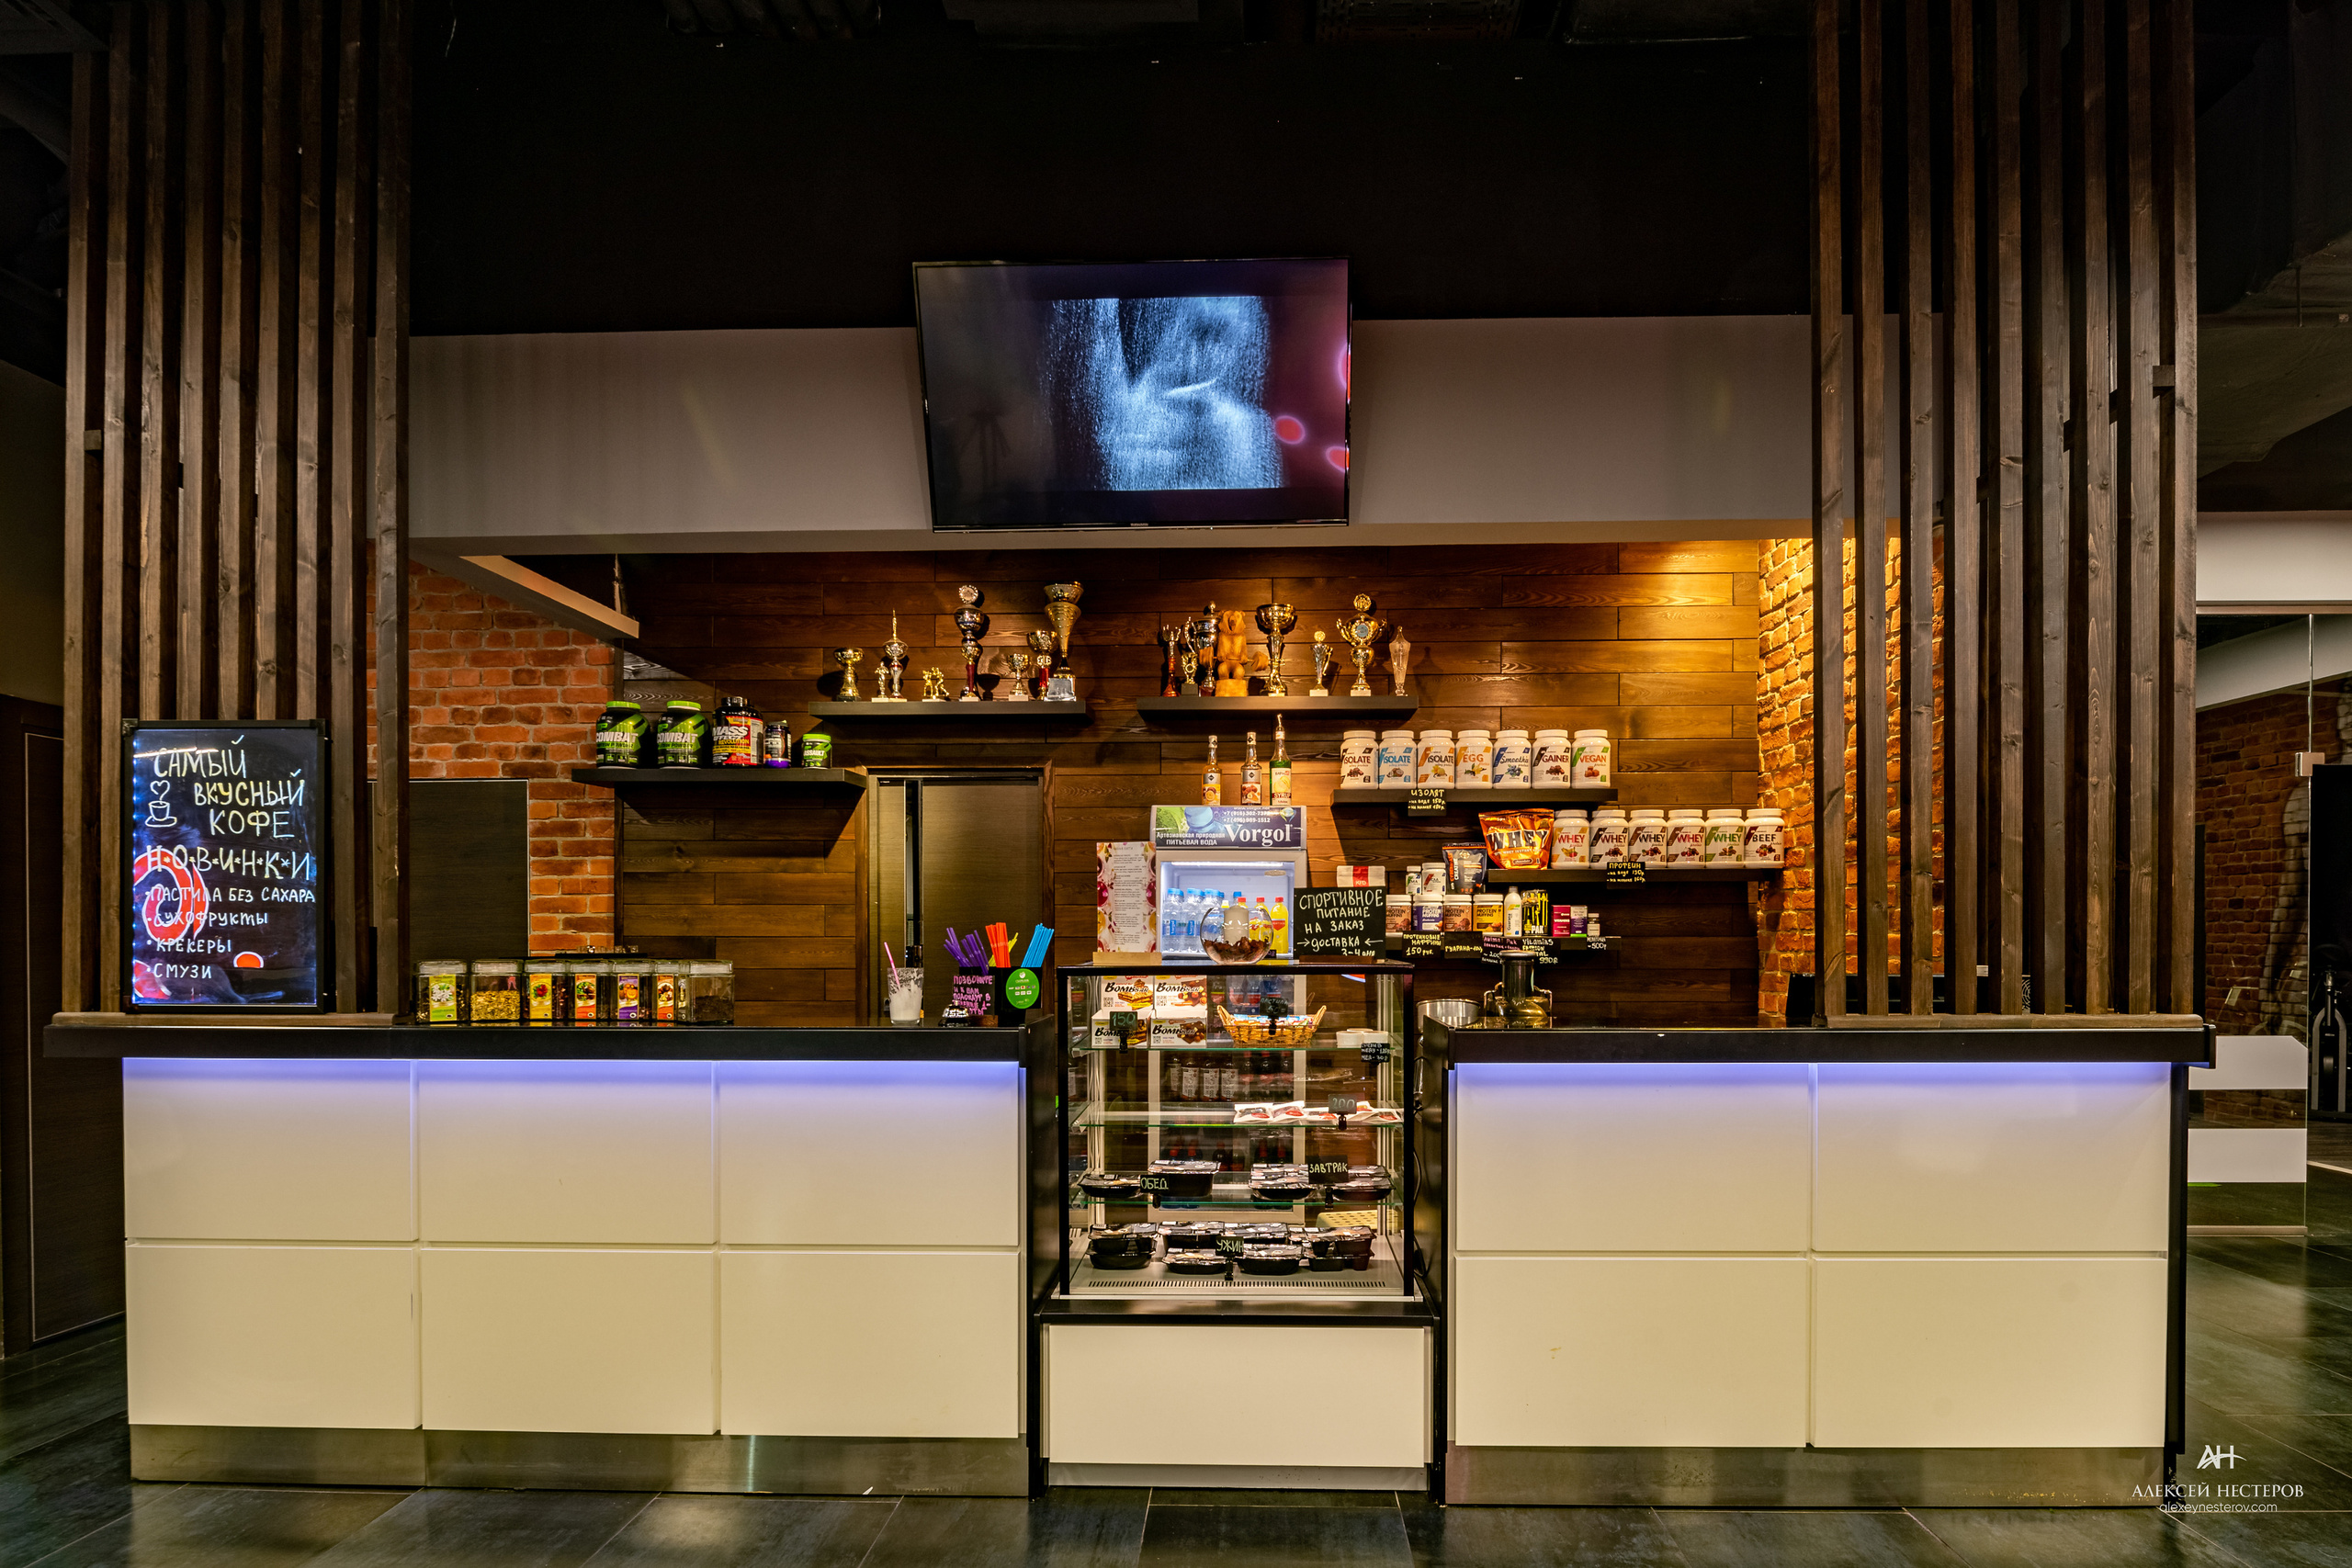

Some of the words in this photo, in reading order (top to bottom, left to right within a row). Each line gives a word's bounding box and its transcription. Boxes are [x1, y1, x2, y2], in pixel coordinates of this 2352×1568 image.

[596, 731, 639, 743] COMBAT
[657, 731, 698, 744] COMBAT
[154, 735, 246, 779] САМЫЙ
[1344, 755, 1372, 764] ISOLATE
[1384, 755, 1411, 764] ISOLATE
[1428, 755, 1453, 763] ISOLATE
[1463, 754, 1484, 762] EGG
[1542, 754, 1570, 763] GAINER
[1579, 754, 1607, 763] VEGAN
[194, 769, 306, 807] ВКУСНЫЙ
[1410, 789, 1444, 797] ИЗОЛЯТ
[209, 809, 295, 838] КОФЕ
[1224, 823, 1291, 847] Vorgol
[1487, 829, 1549, 851] WHEY
[1557, 834, 1585, 843] WHEY
[1600, 834, 1627, 843] WHEY
[1638, 833, 1666, 843] WHEY
[1677, 833, 1703, 843] WHEY
[1713, 833, 1742, 842] WHEY
[1752, 833, 1777, 842] BEEF
[229, 887, 254, 903] БЕЗ
[261, 887, 315, 903] САХАРА
[1299, 889, 1383, 909] СПОРТИВНОЕ
[1317, 907, 1370, 919] ПИТАНИЕ
[1305, 922, 1322, 934] НА
[1330, 920, 1364, 931] ЗАКАЗ
[1532, 925, 1544, 934] PAK
[156, 938, 232, 953] КРЕКЕРЫ
[153, 963, 212, 979] СМУЗИ
[1112, 1012, 1136, 1026] 150
[1309, 1161, 1348, 1174] ЗАВТРАК
[1140, 1177, 1169, 1190] ОБЕД
[1216, 1239, 1244, 1253] УЖИН
